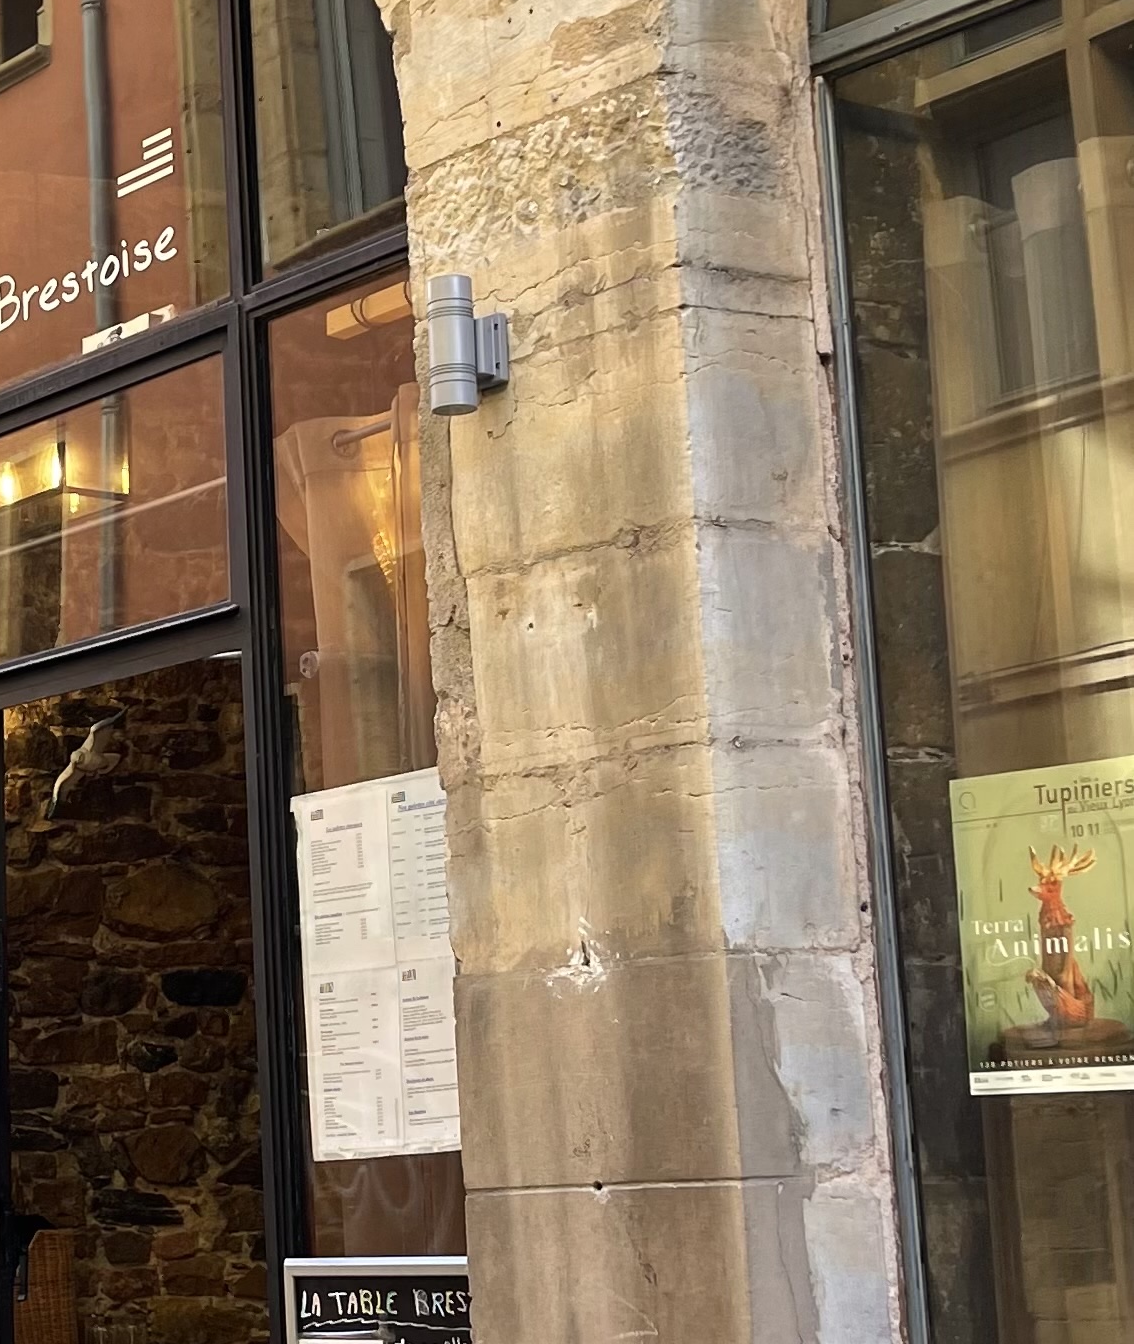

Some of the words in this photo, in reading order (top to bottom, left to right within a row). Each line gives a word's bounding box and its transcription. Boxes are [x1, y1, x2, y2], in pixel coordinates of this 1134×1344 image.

[971, 918, 1024, 937] Terra
[990, 927, 1132, 958] Animalis
[300, 1290, 321, 1317] LA
[328, 1288, 398, 1316] TABLE
[413, 1288, 472, 1318] BRES
